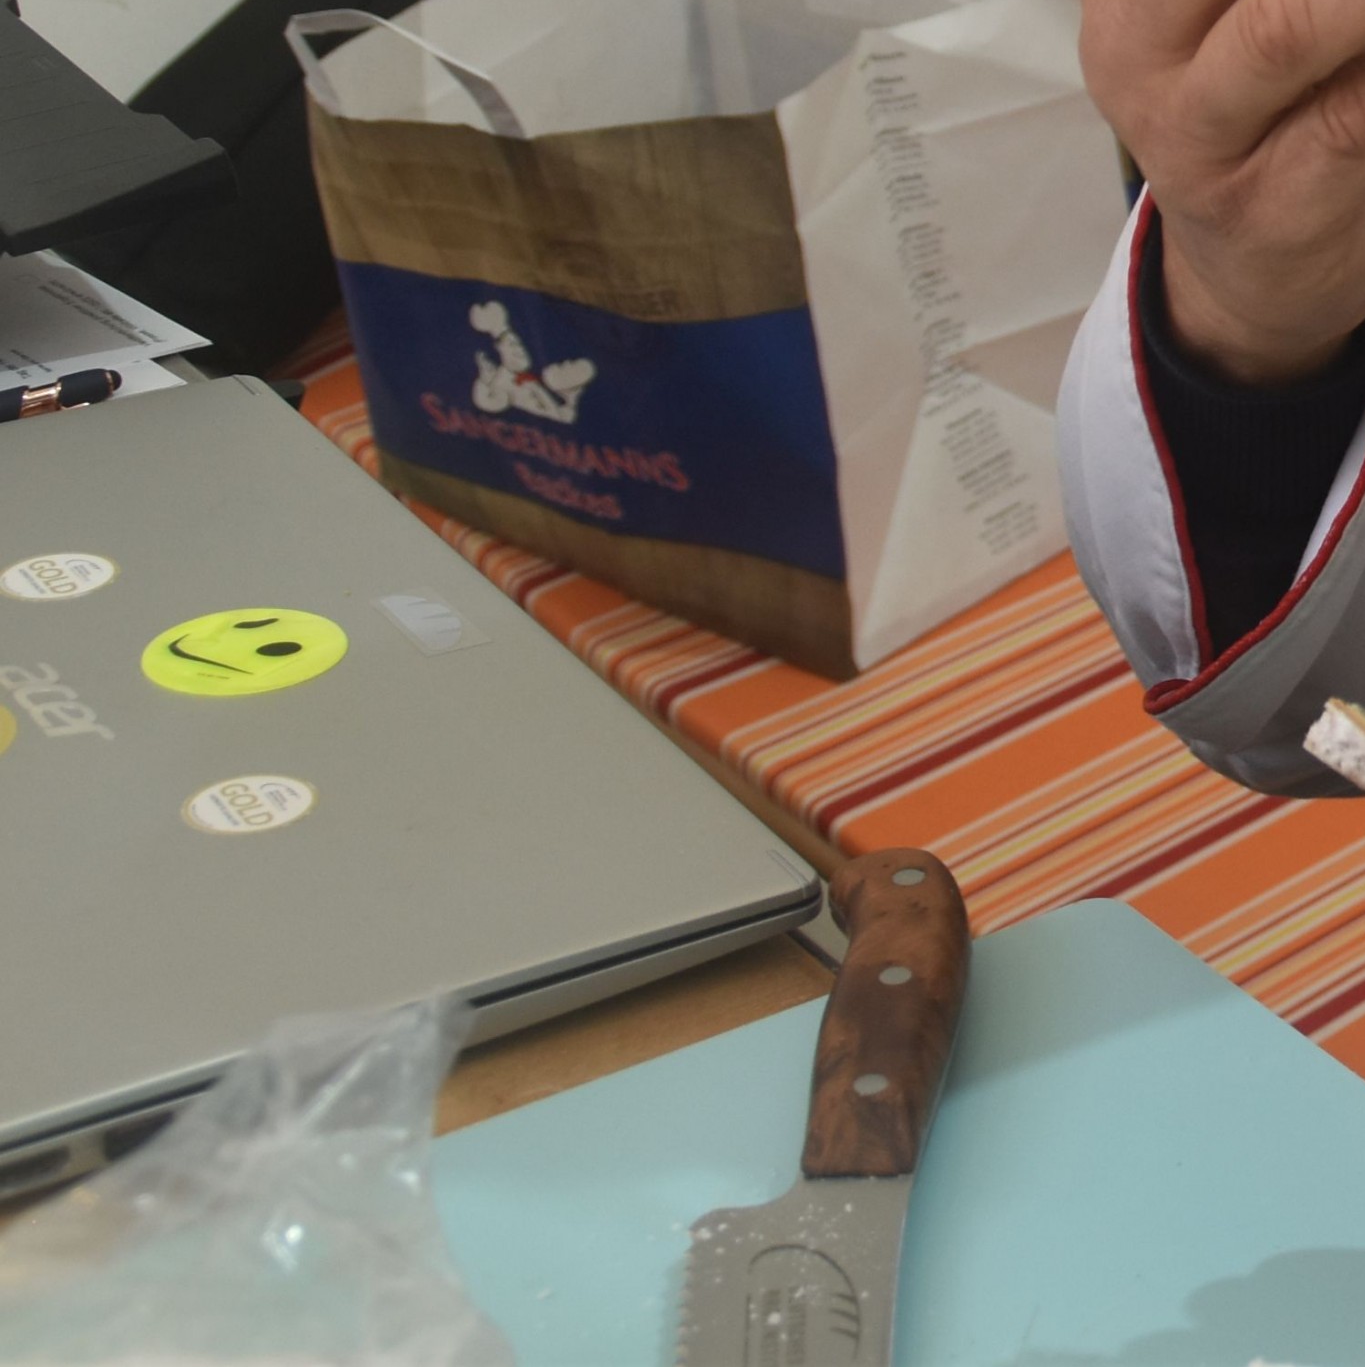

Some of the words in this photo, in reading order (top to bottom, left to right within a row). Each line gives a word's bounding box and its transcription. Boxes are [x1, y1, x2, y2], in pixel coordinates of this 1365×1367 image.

[28, 559, 78, 594] GOLD
[0, 661, 115, 740] acer
[219, 782, 275, 826] GOLD
